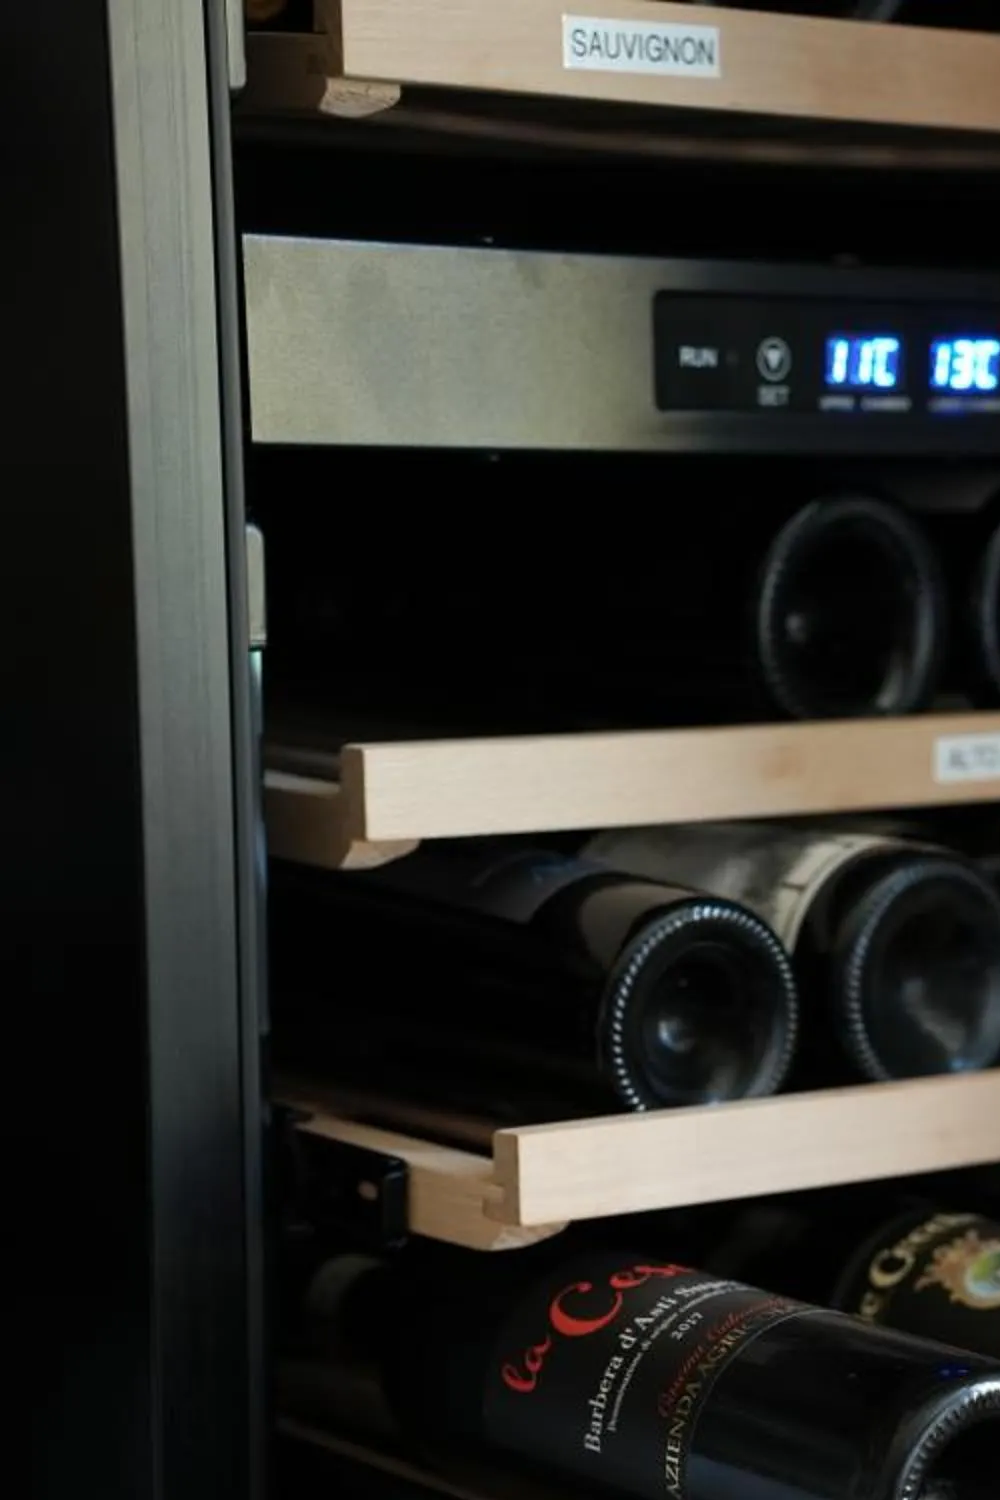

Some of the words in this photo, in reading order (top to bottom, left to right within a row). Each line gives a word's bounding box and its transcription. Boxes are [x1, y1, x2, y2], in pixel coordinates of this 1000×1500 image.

[571, 28, 715, 66] SAUVIGNON
[678, 346, 719, 368] RUN
[584, 1356, 625, 1453] Barbera
[617, 1295, 678, 1350] d'Asti
[664, 1379, 703, 1500] AZIENDA
